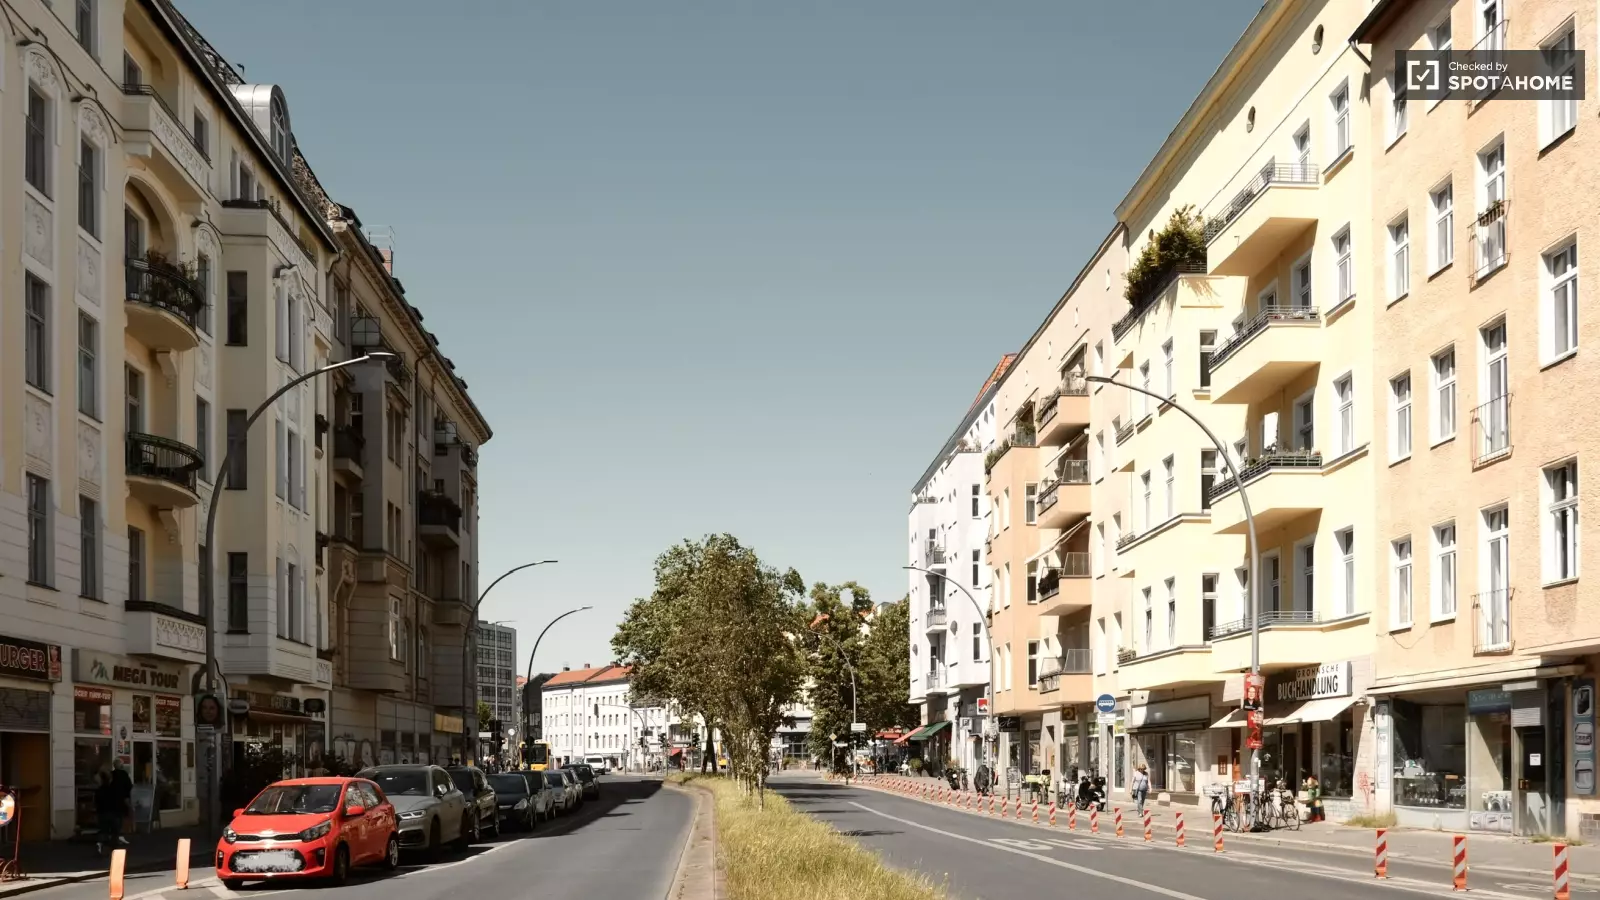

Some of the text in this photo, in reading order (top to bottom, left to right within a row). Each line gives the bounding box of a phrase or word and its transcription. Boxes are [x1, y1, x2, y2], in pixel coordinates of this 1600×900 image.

[0, 643, 46, 673] URGER
[112, 665, 147, 685] MEGA
[149, 670, 179, 689] TOUR
[1277, 674, 1339, 701] BUCHHANDLUNG
